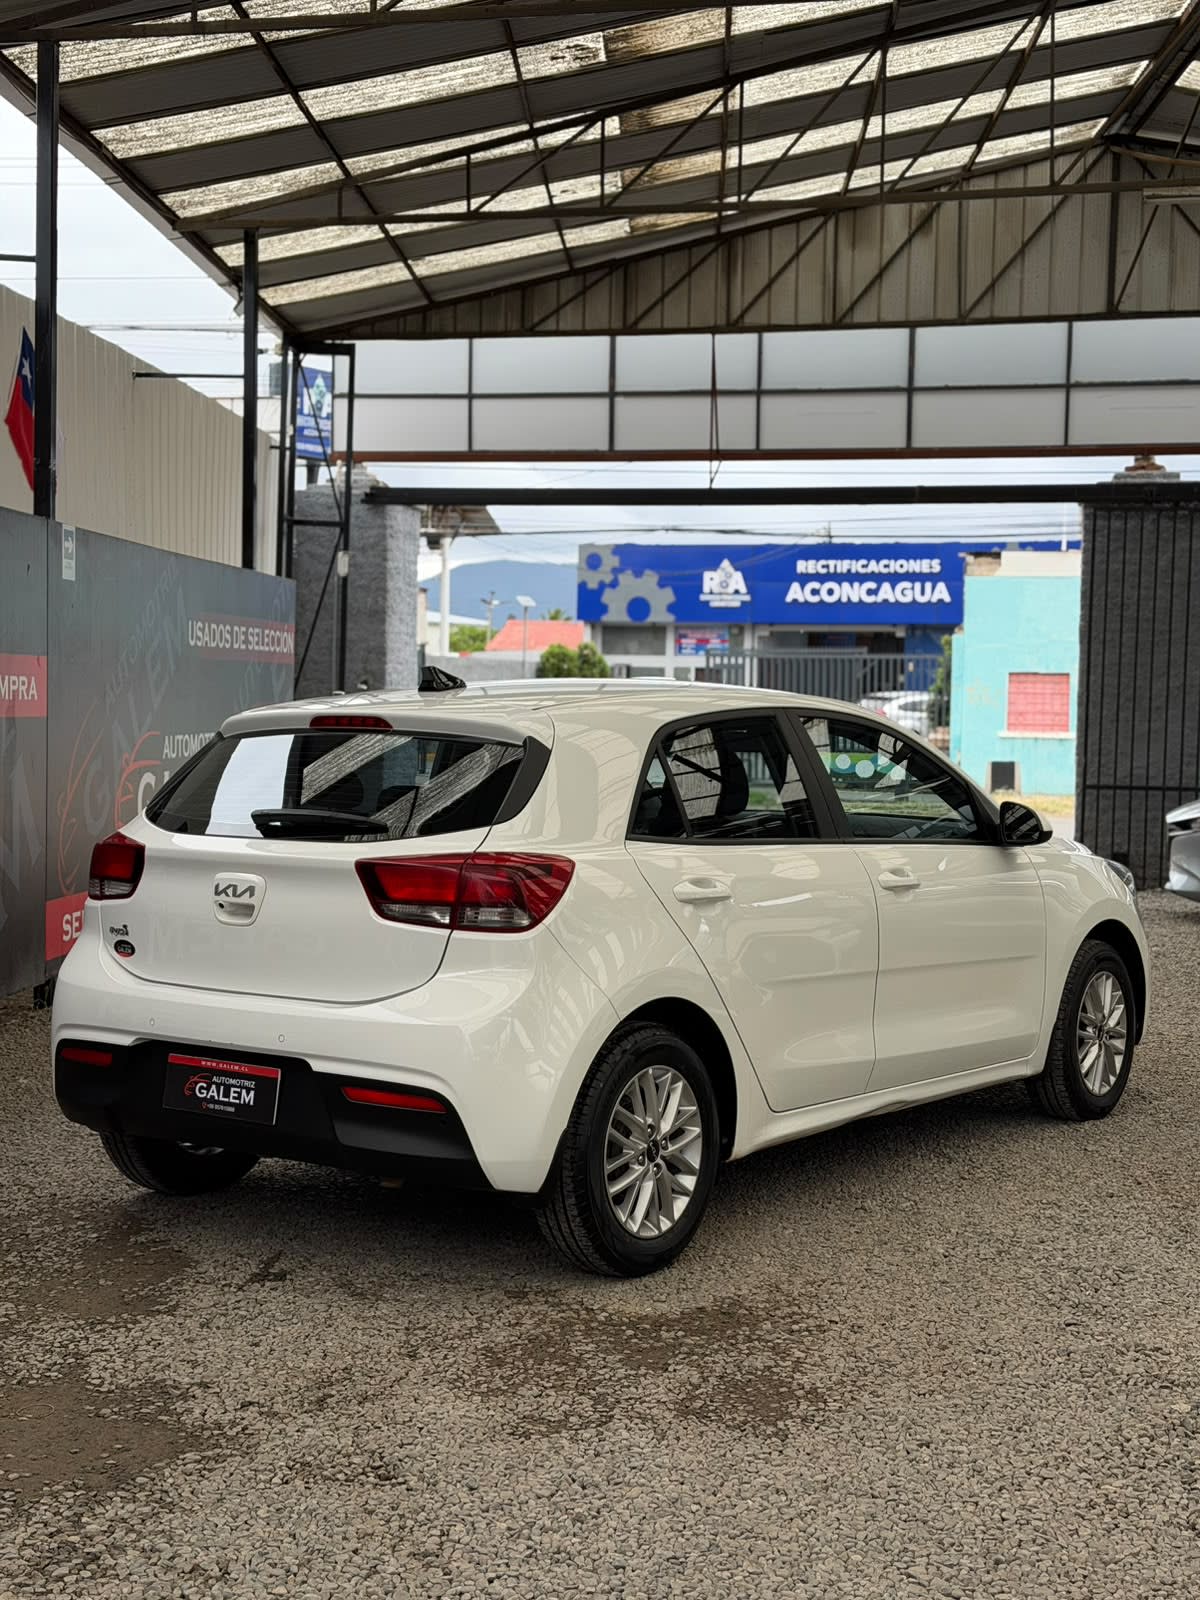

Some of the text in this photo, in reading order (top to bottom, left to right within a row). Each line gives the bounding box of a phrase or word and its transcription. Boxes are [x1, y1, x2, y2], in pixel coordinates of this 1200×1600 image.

[796, 559, 941, 574] RECTIFICACIONES
[785, 581, 952, 603] ACONCAGUA
[188, 619, 295, 654] USADOS DE SELECCIÓN
[214, 883, 256, 898] KIA
[62, 910, 85, 942] SE
[212, 1075, 256, 1088] AUTOMOTRIZ
[195, 1082, 255, 1106] GALEM
